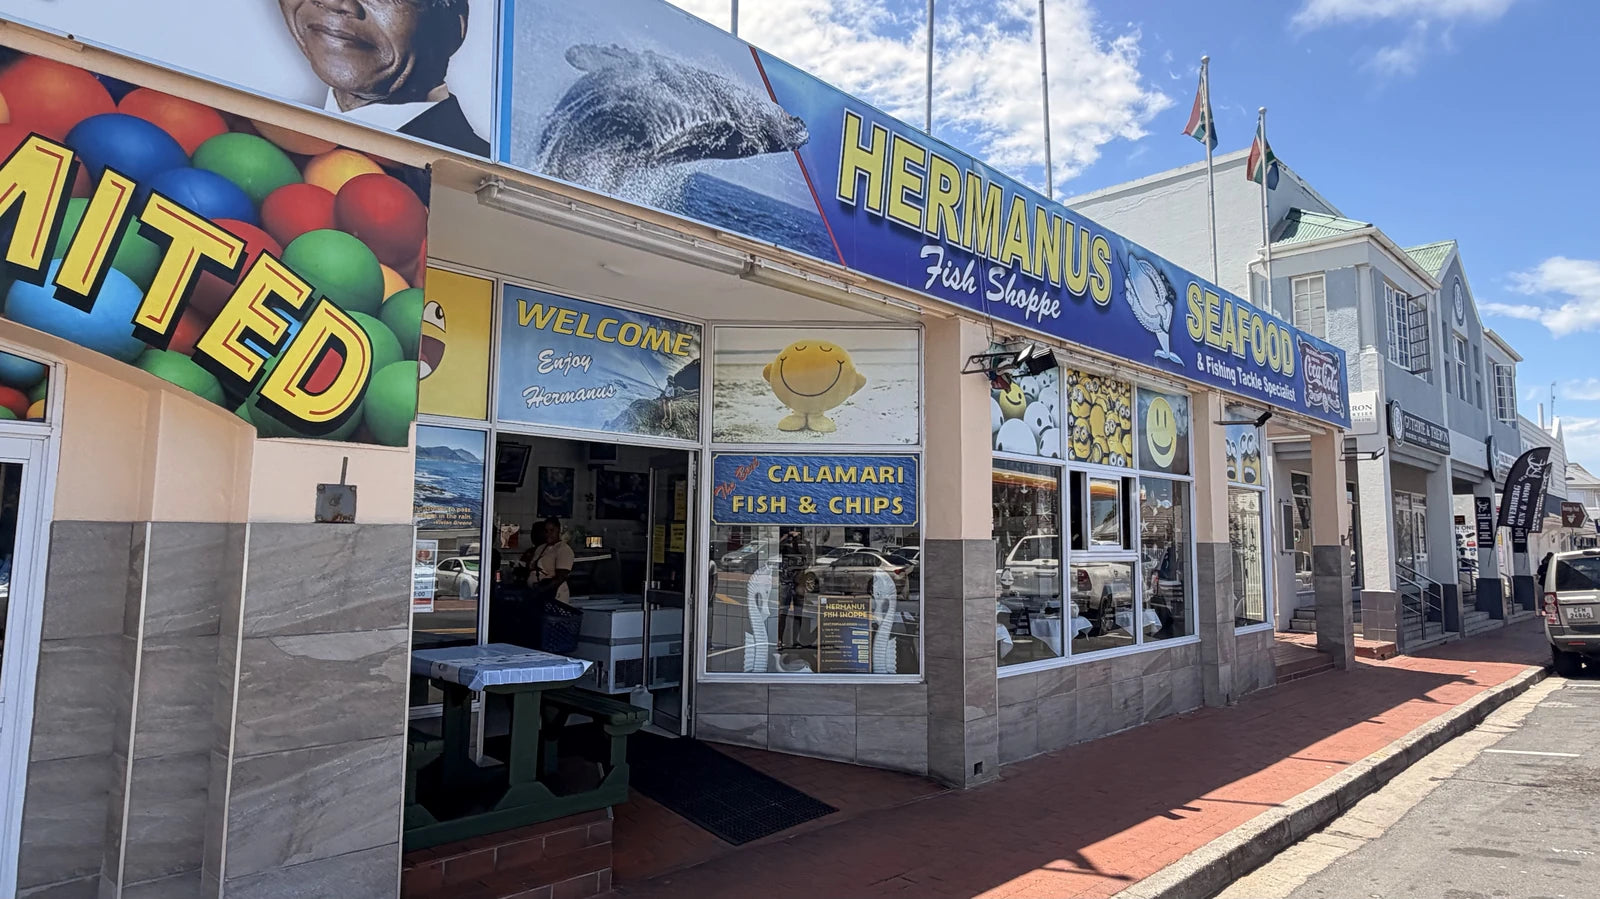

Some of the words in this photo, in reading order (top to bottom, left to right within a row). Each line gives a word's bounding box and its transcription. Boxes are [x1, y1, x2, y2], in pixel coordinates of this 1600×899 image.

[836, 107, 1113, 306] HERMANUS
[920, 245, 977, 294] Fish
[986, 267, 1062, 323] Shoppe
[517, 299, 693, 357] WELCOME
[1186, 280, 1295, 378] SEAFOOD
[537, 349, 593, 377] Enjoy
[1197, 352, 1204, 371] &
[1205, 355, 1236, 386] Fishing
[1237, 366, 1262, 390] Tackle
[1263, 376, 1297, 402] Specialist
[522, 383, 617, 409] Hermanus
[767, 465, 905, 484] CALAMARI
[732, 495, 787, 514] FISH
[798, 495, 818, 515] &
[828, 496, 904, 515] CHIPS
